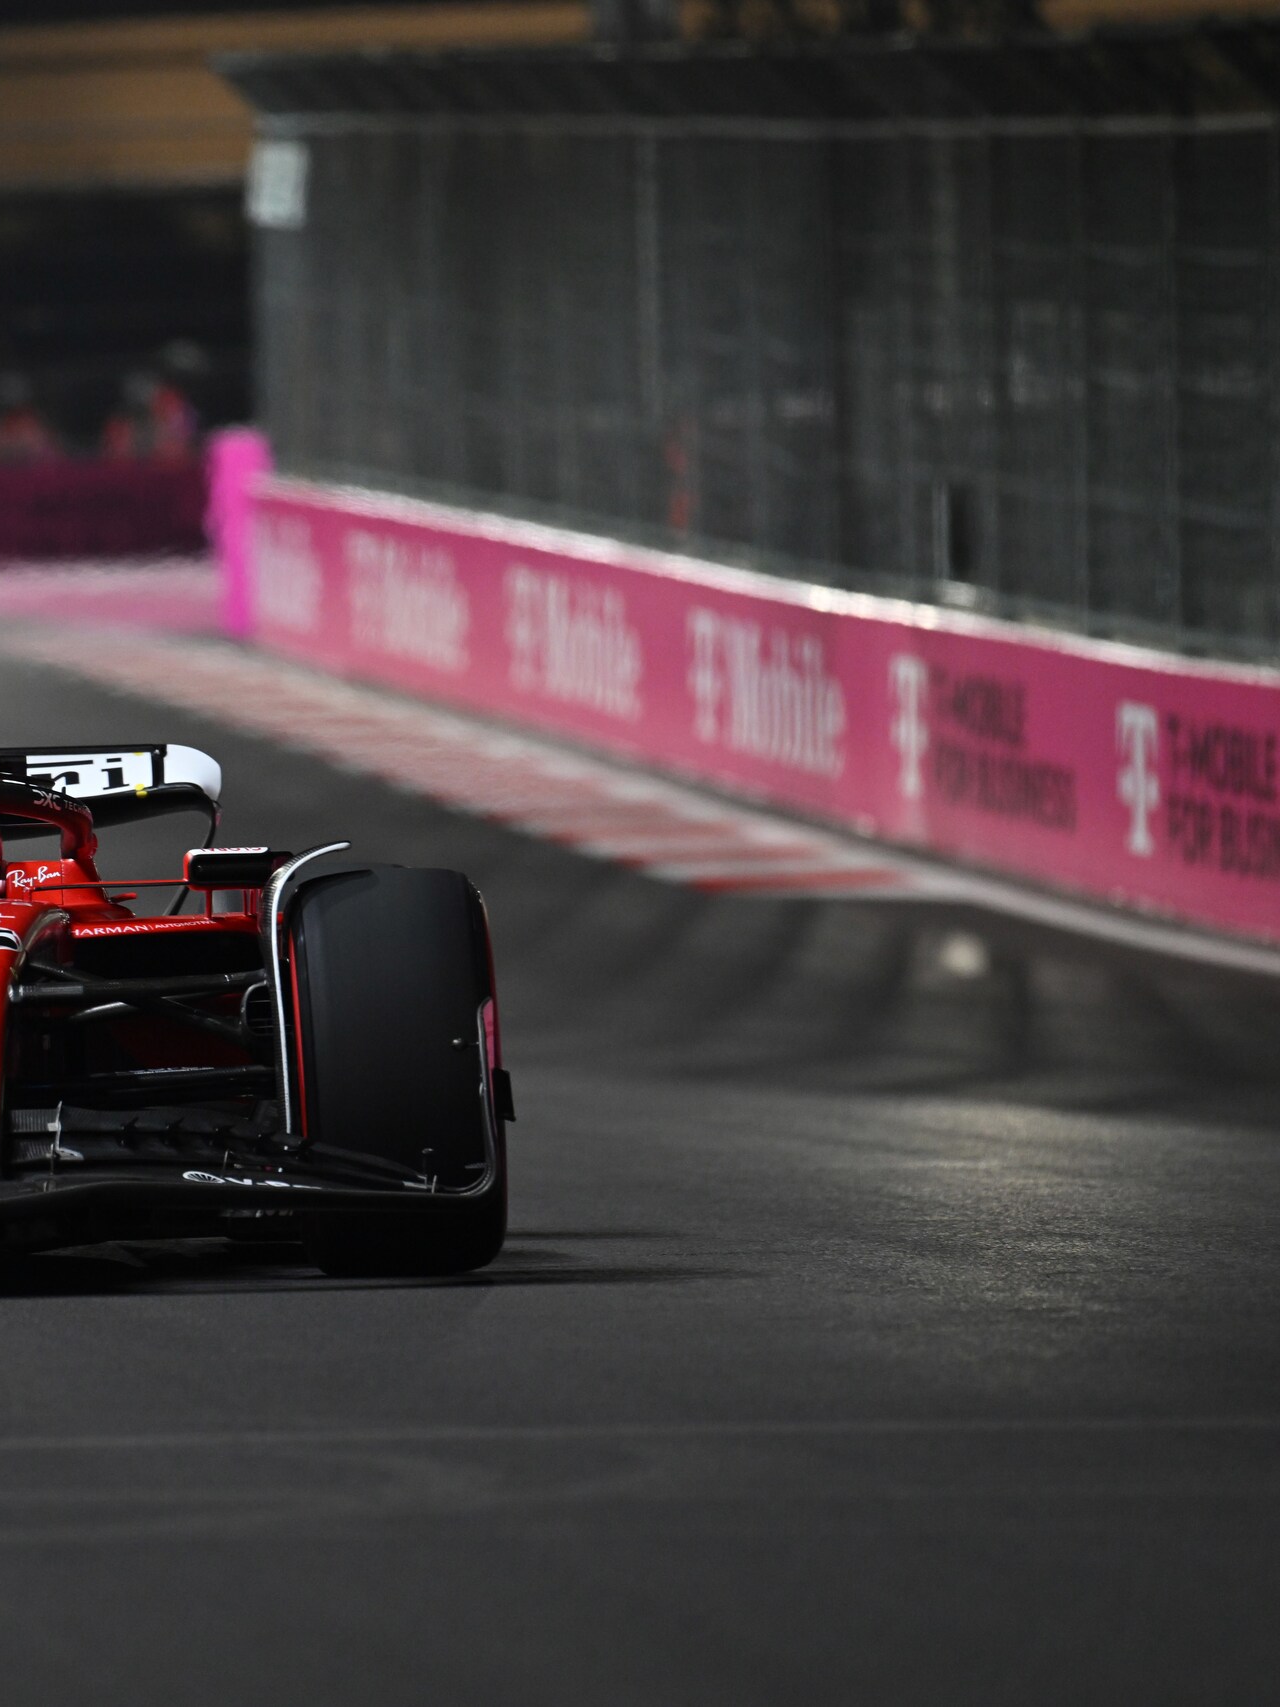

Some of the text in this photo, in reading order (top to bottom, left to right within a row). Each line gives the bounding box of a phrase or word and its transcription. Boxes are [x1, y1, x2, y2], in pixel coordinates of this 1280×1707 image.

[6, 865, 62, 888] Ray-Ban
[70, 919, 217, 937] HARMAN AUTOMOTIVE
